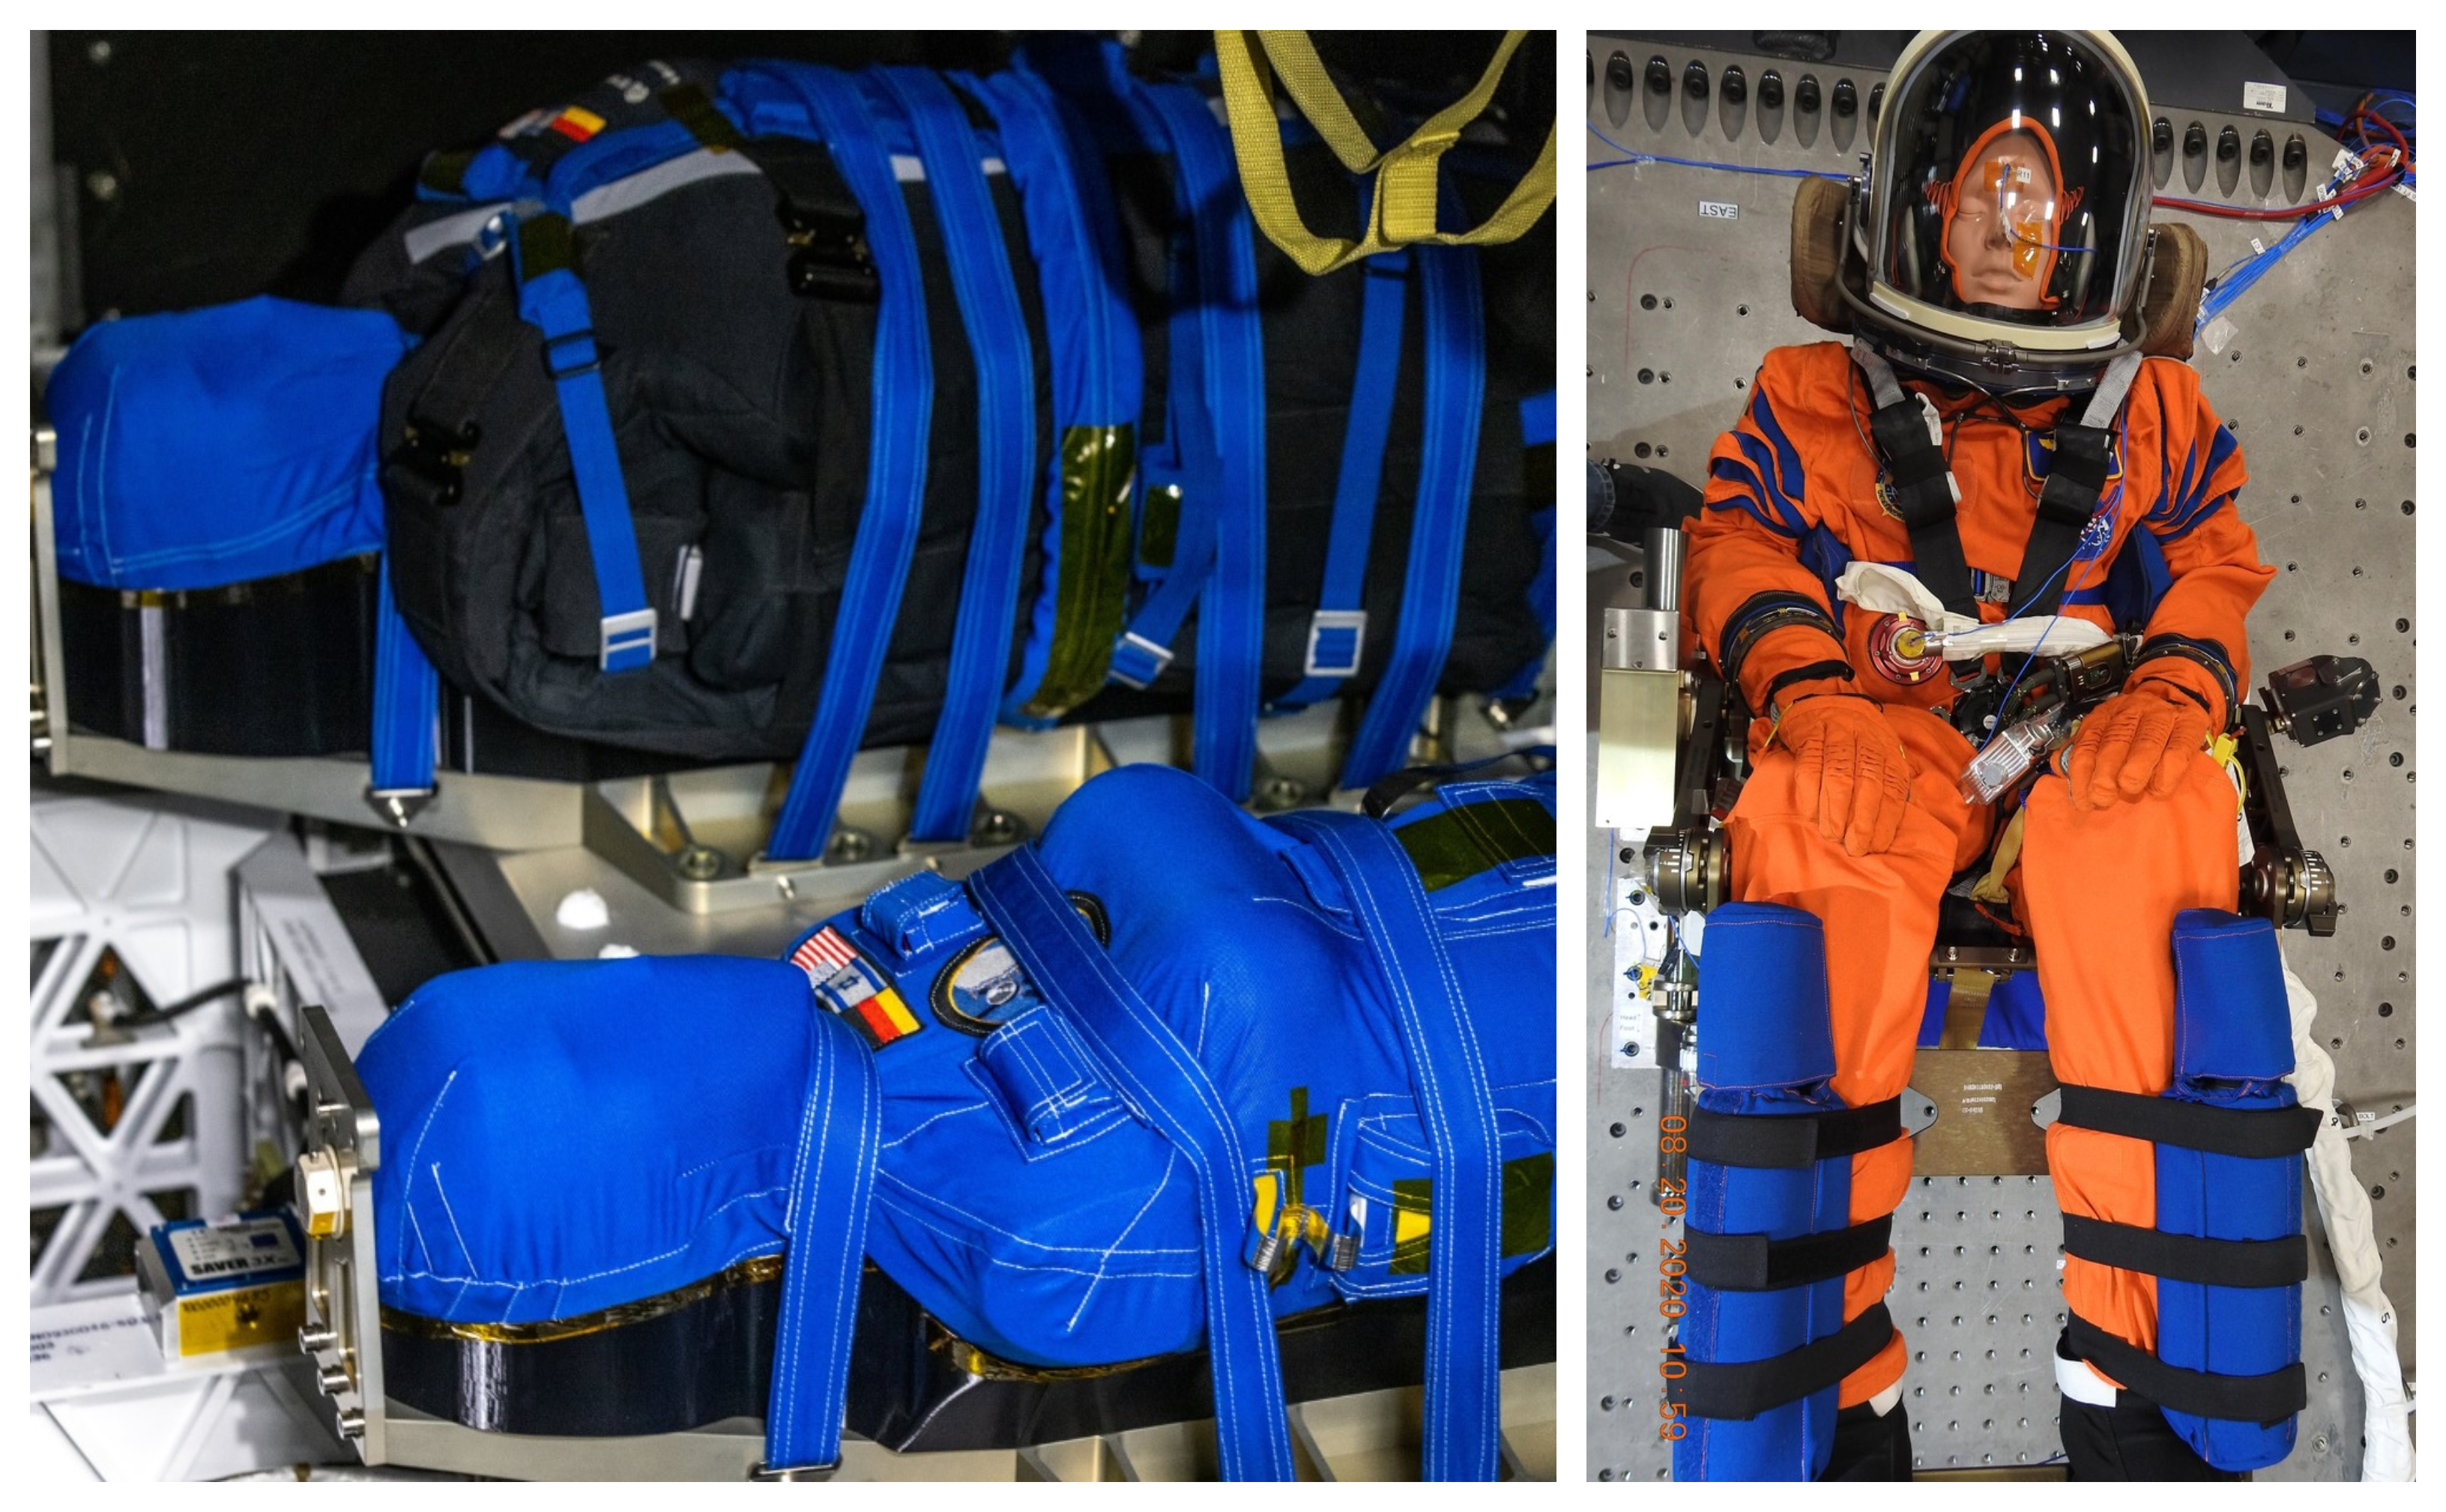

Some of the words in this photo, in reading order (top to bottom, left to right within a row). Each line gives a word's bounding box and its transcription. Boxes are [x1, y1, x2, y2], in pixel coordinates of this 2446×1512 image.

[2017, 170, 2029, 180] R11
[1700, 204, 1737, 219] EAST
[190, 1257, 250, 1275] SAVER
